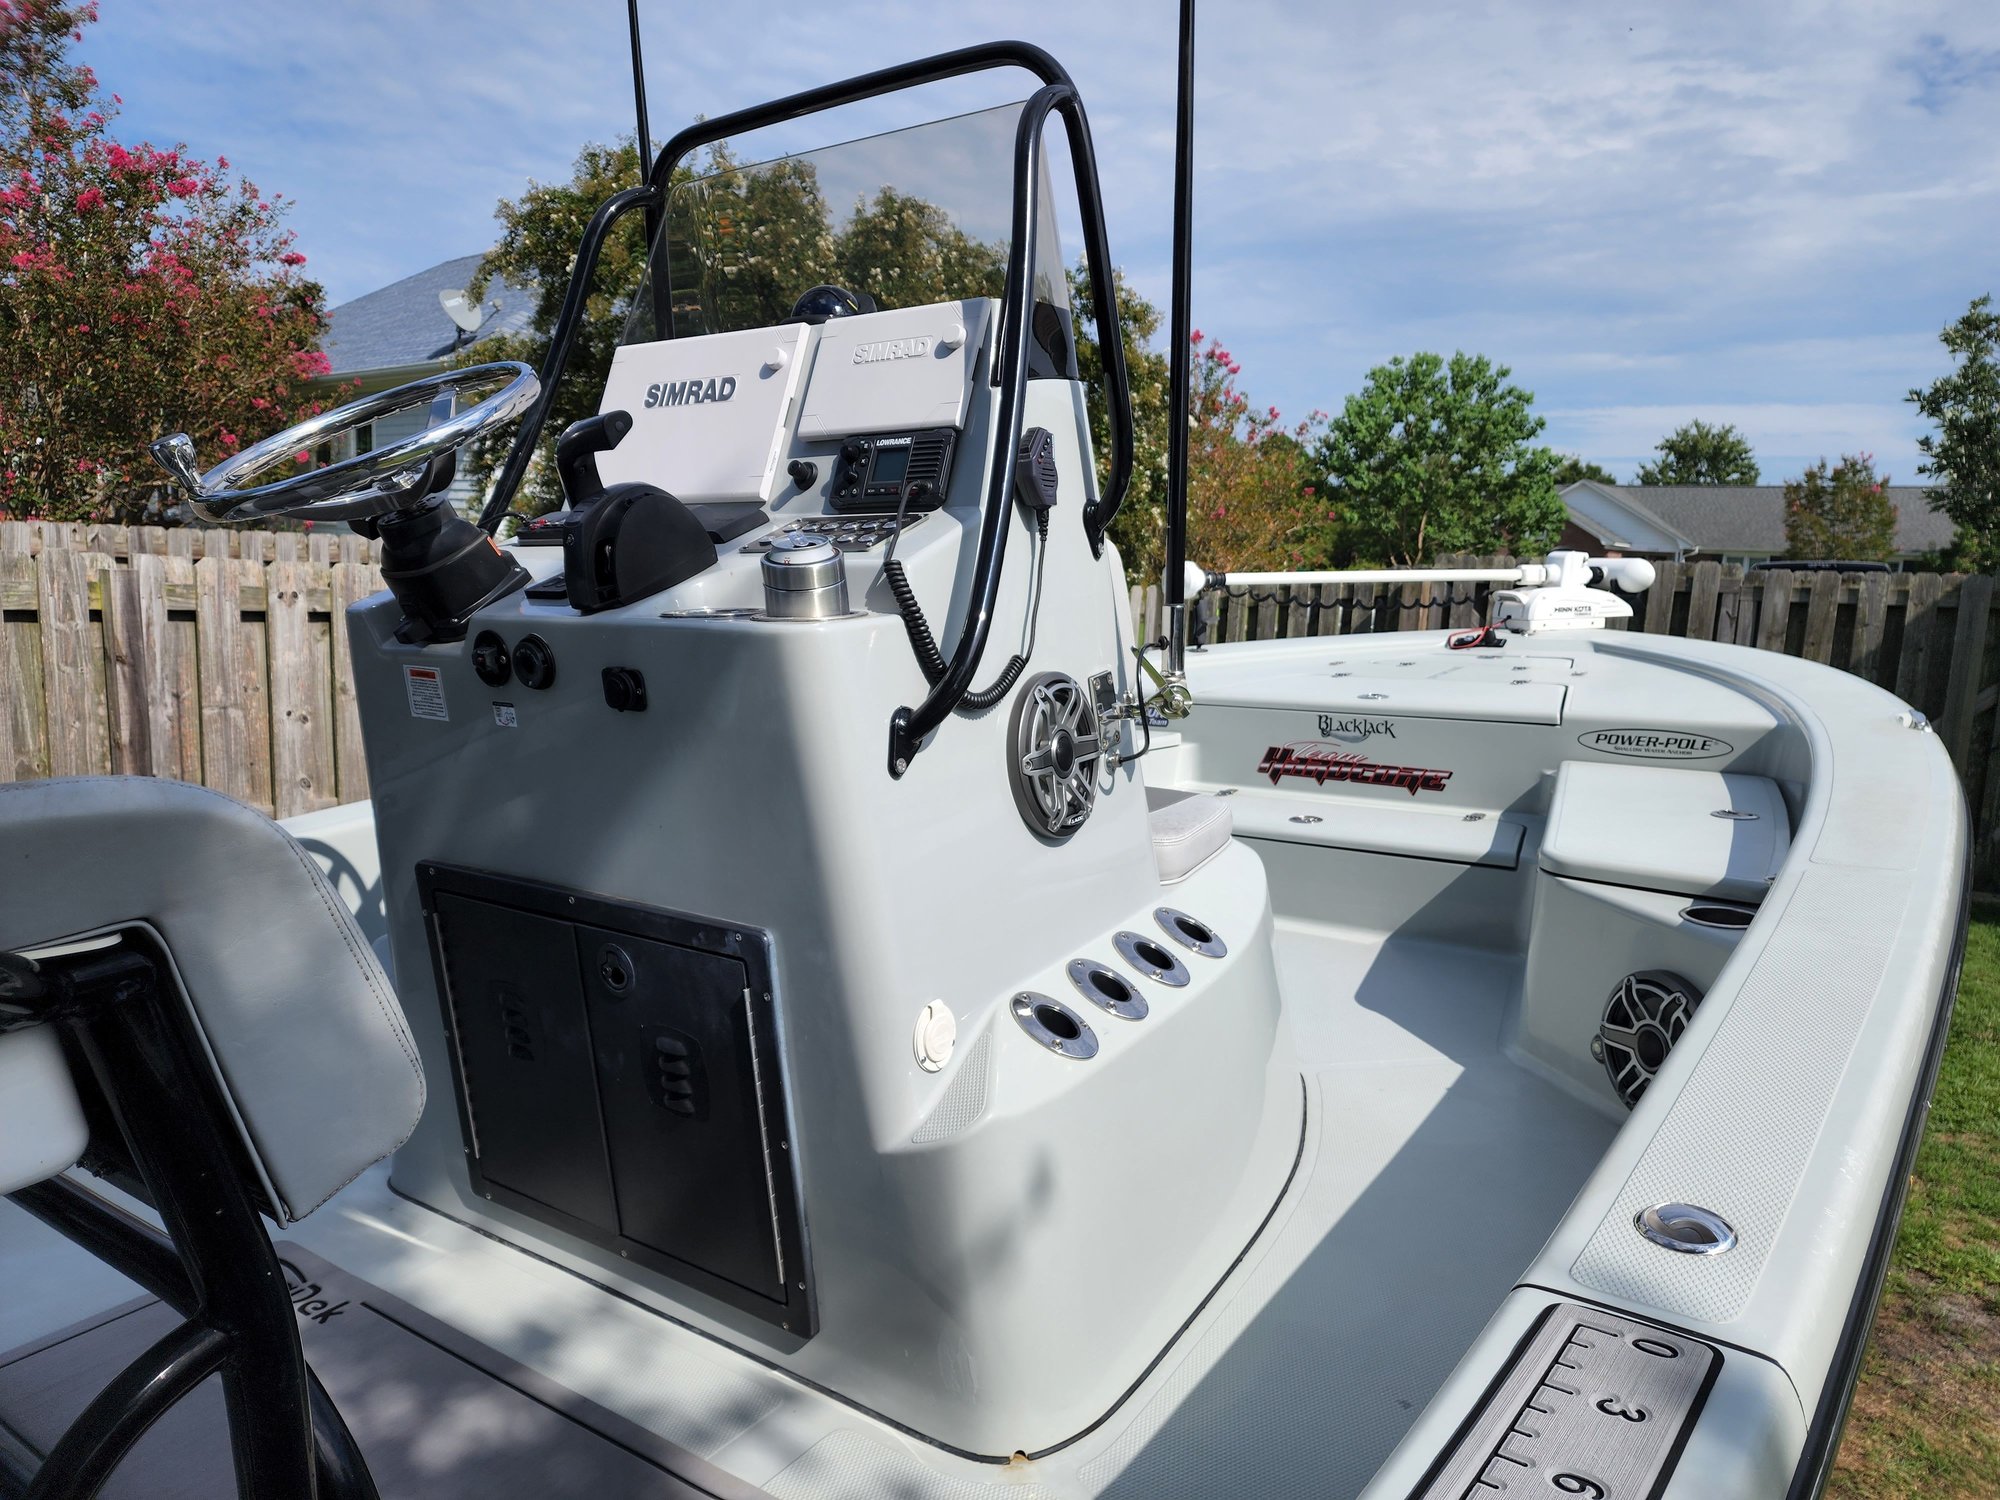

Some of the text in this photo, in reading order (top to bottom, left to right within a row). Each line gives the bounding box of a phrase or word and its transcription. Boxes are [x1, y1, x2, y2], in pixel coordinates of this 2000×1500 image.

[853, 337, 931, 364] SIMRAD
[644, 376, 737, 409] SIMRAD
[876, 437, 912, 447] LOWRANCE
[1595, 733, 1712, 751] POWER-POLE
[1257, 746, 1453, 796] HARDCORE
[1631, 1338, 1679, 1359] 0
[1596, 1397, 1647, 1423] 3
